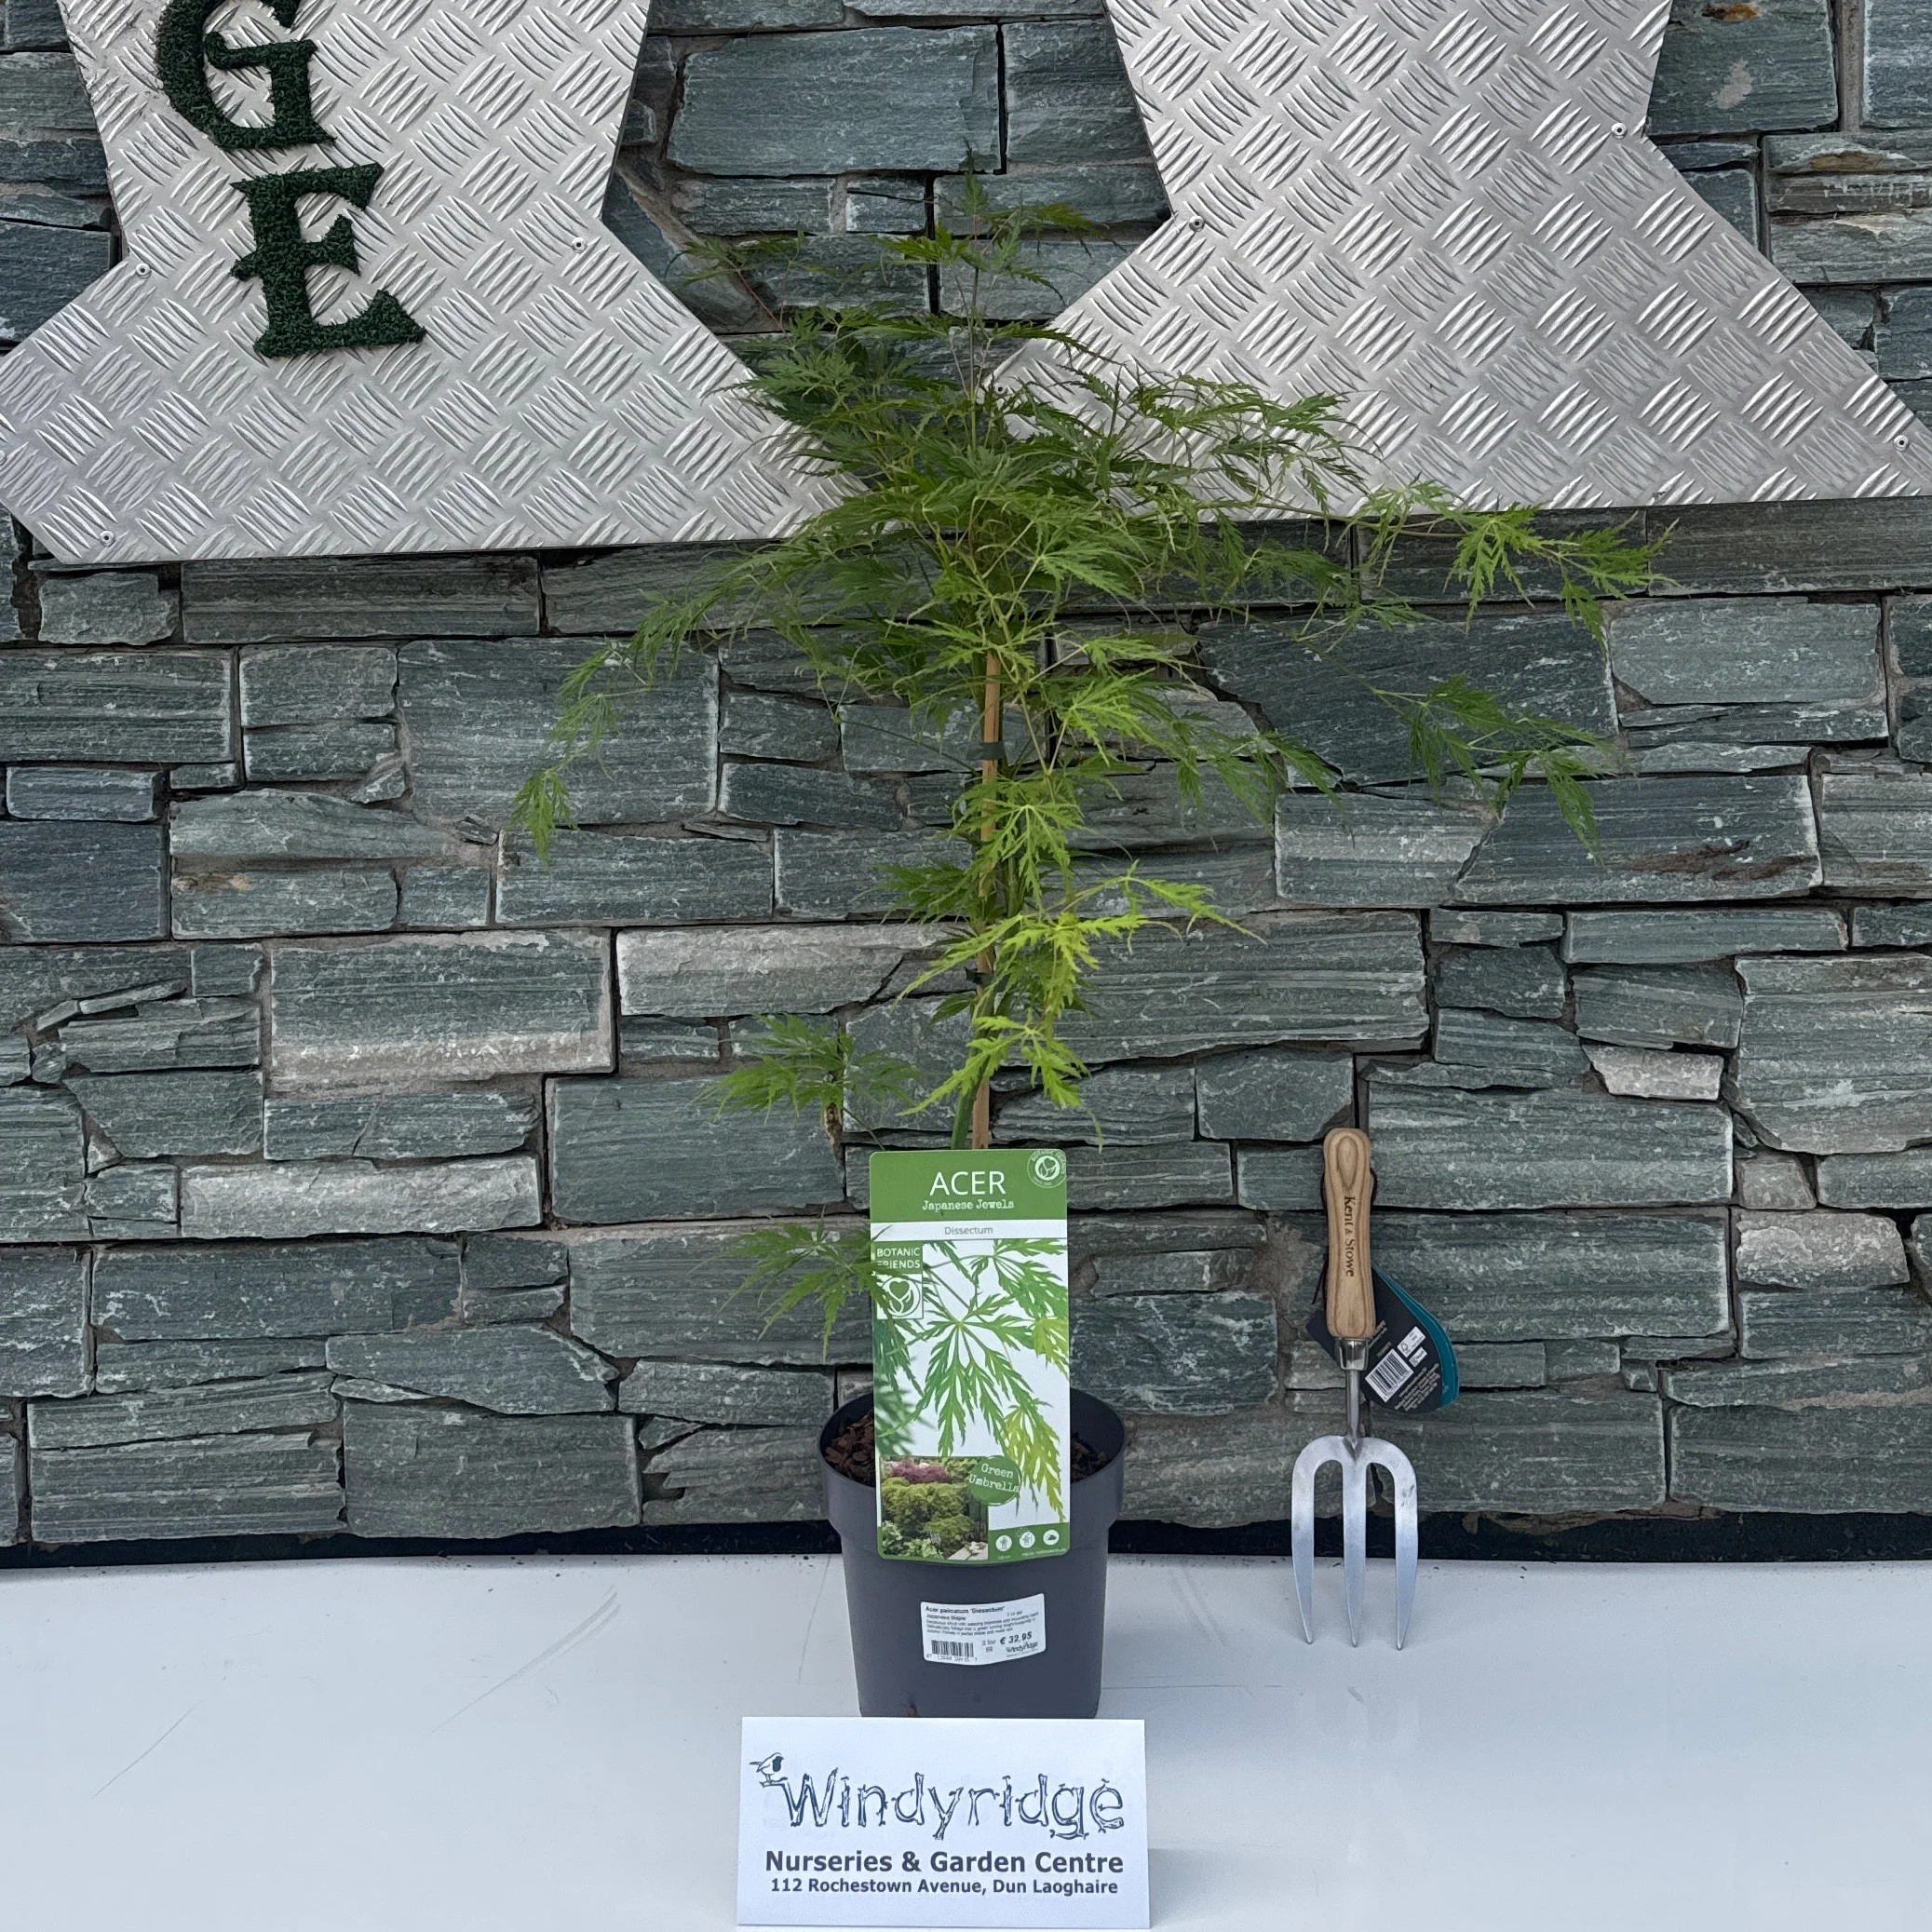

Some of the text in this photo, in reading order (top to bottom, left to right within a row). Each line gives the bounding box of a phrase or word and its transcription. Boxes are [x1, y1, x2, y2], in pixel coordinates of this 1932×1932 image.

[929, 1170, 1007, 1196] ACER
[922, 1198, 1015, 1213] Japanese Jewels
[1344, 1195, 1356, 1226] Kent
[944, 1225, 993, 1236] Dissectum
[876, 1248, 921, 1257] BOTANIC
[1344, 1238, 1355, 1277] Stowe
[980, 1463, 1014, 1479] Green
[968, 1473, 1020, 1493] Umbrella
[761, 1767, 1125, 1841] Windyridge
[765, 1850, 1124, 1873] Nurseries & Garden Centre
[771, 1878, 1118, 1897] 112 Rochestown Avenue, Dun Laoghaire
